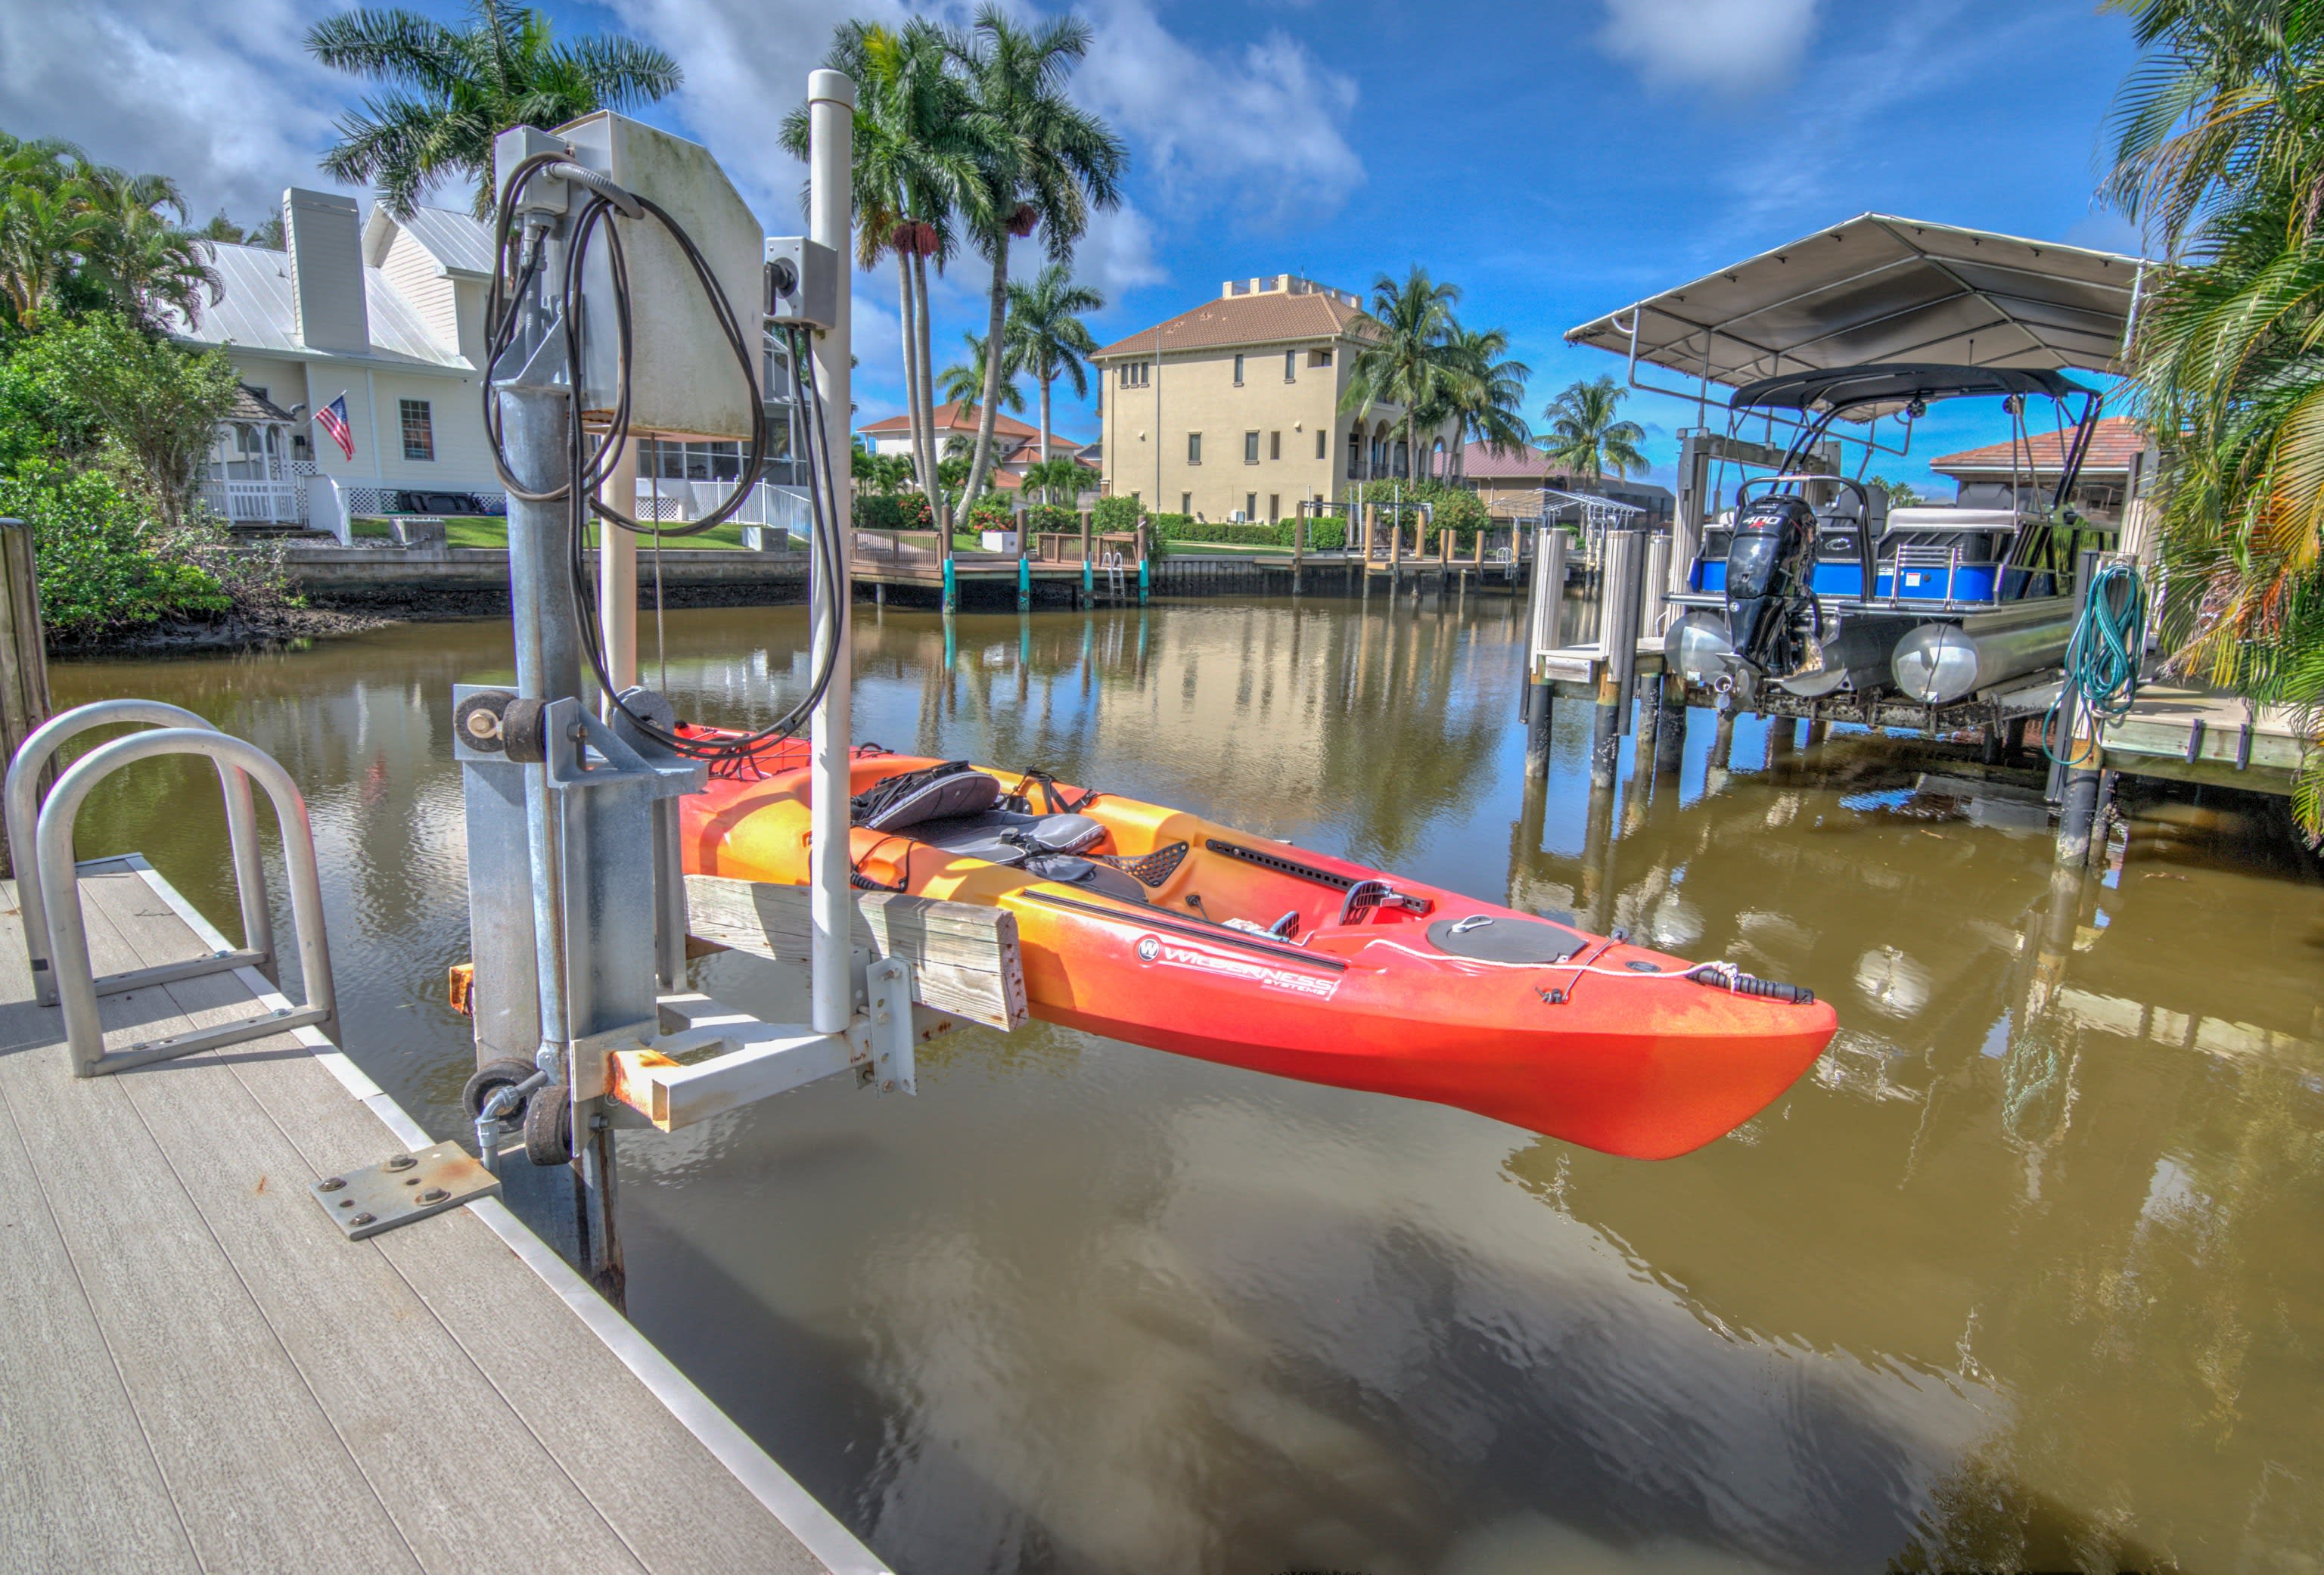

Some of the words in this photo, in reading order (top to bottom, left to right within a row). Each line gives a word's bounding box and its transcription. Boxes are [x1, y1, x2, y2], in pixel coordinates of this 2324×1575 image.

[1742, 516, 1782, 524] 400
[1139, 939, 1159, 958] W
[1164, 946, 1334, 991] WILDERNESS
[1263, 978, 1328, 996] SYSTEMS
